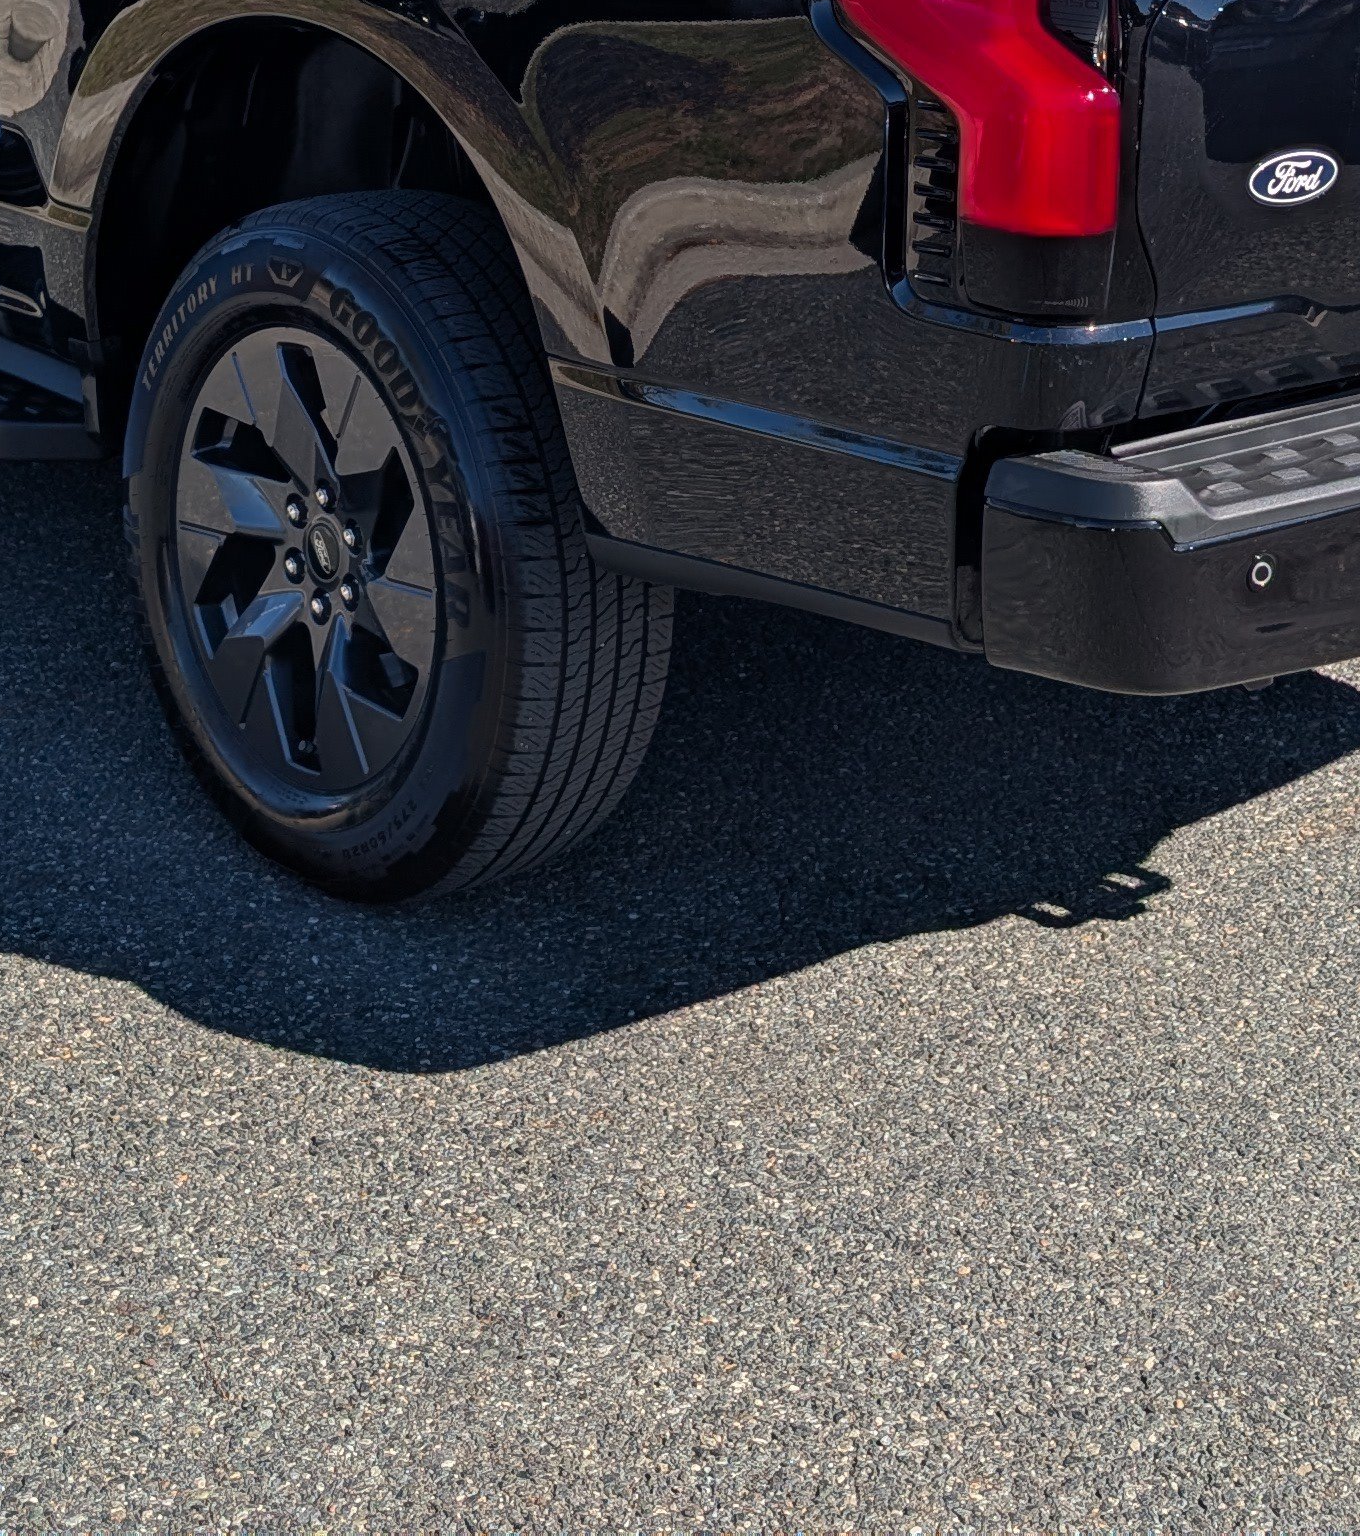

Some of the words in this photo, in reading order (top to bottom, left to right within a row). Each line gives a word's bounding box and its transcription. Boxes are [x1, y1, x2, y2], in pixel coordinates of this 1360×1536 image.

[1267, 159, 1324, 196] Ford
[141, 273, 218, 393] TERRITORY
[230, 262, 255, 285] HT
